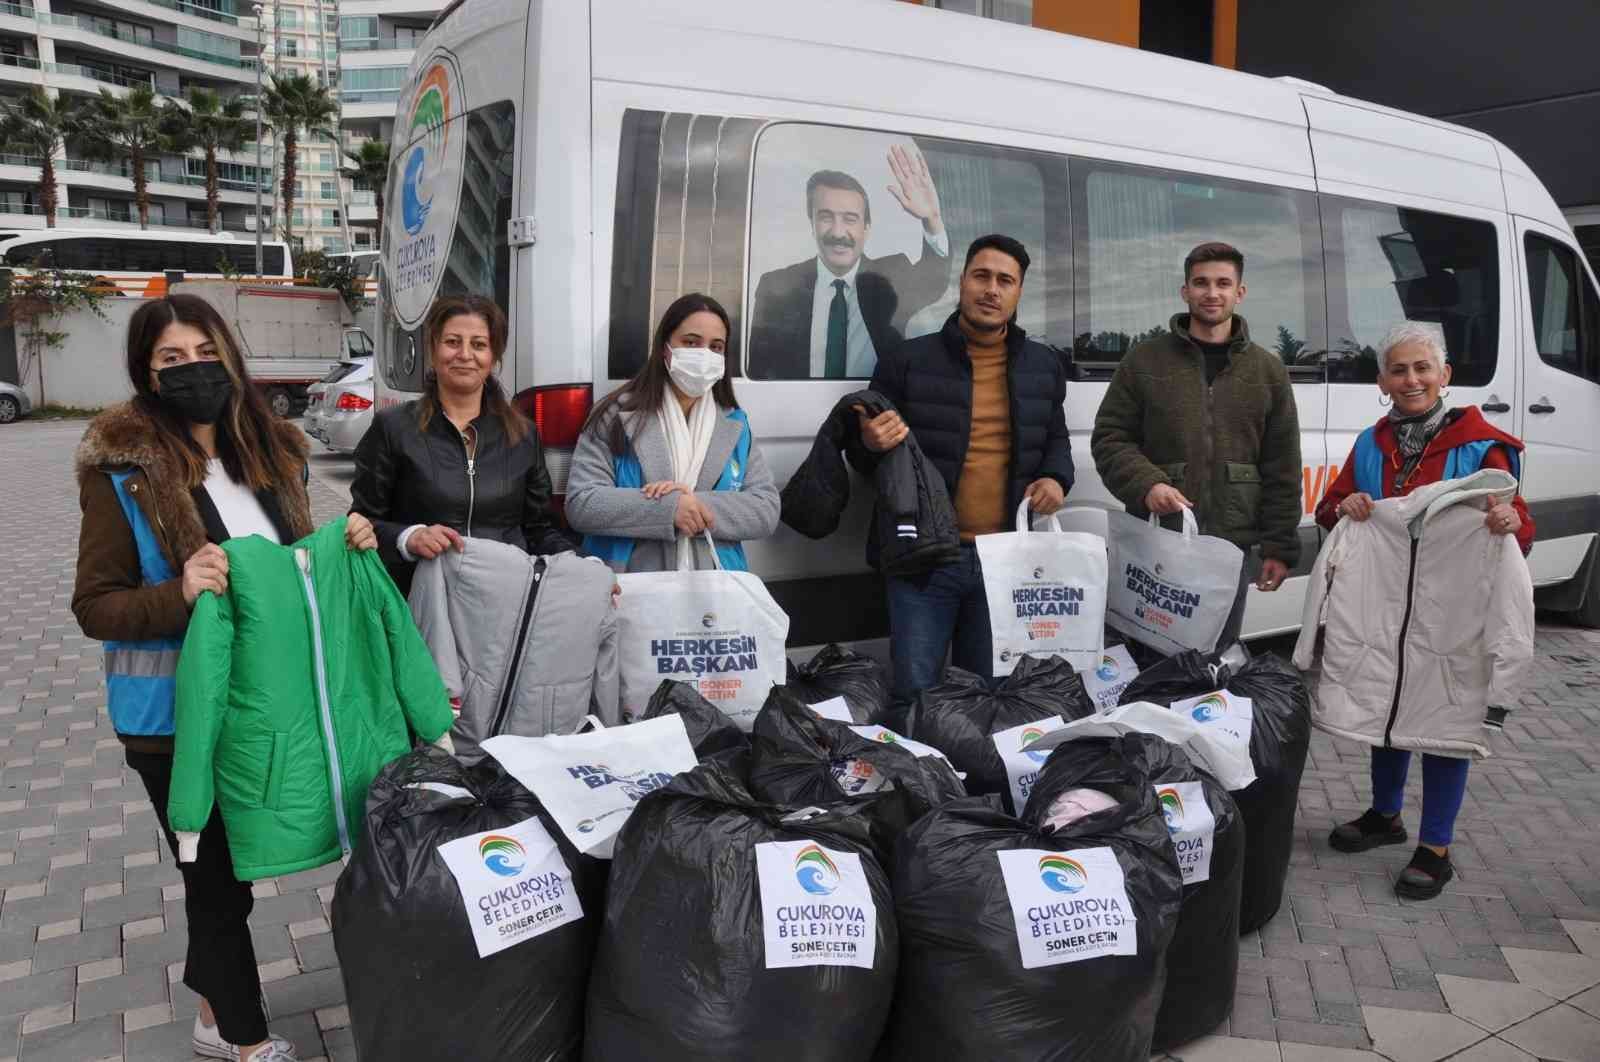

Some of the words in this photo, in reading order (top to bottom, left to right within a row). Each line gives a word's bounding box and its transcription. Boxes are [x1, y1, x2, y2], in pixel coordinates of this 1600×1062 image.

[657, 654, 758, 678] BAŞKANI
[478, 871, 562, 914] ÇUKUROVA
[483, 884, 566, 926] BELEDİYESİ
[776, 904, 865, 926] ÇUKUROVA
[1027, 898, 1121, 926] ÇUKUROVA
[498, 915, 535, 936] SONER
[1031, 914, 1126, 938] BELEDİYESİ
[1046, 935, 1086, 951] SONER
